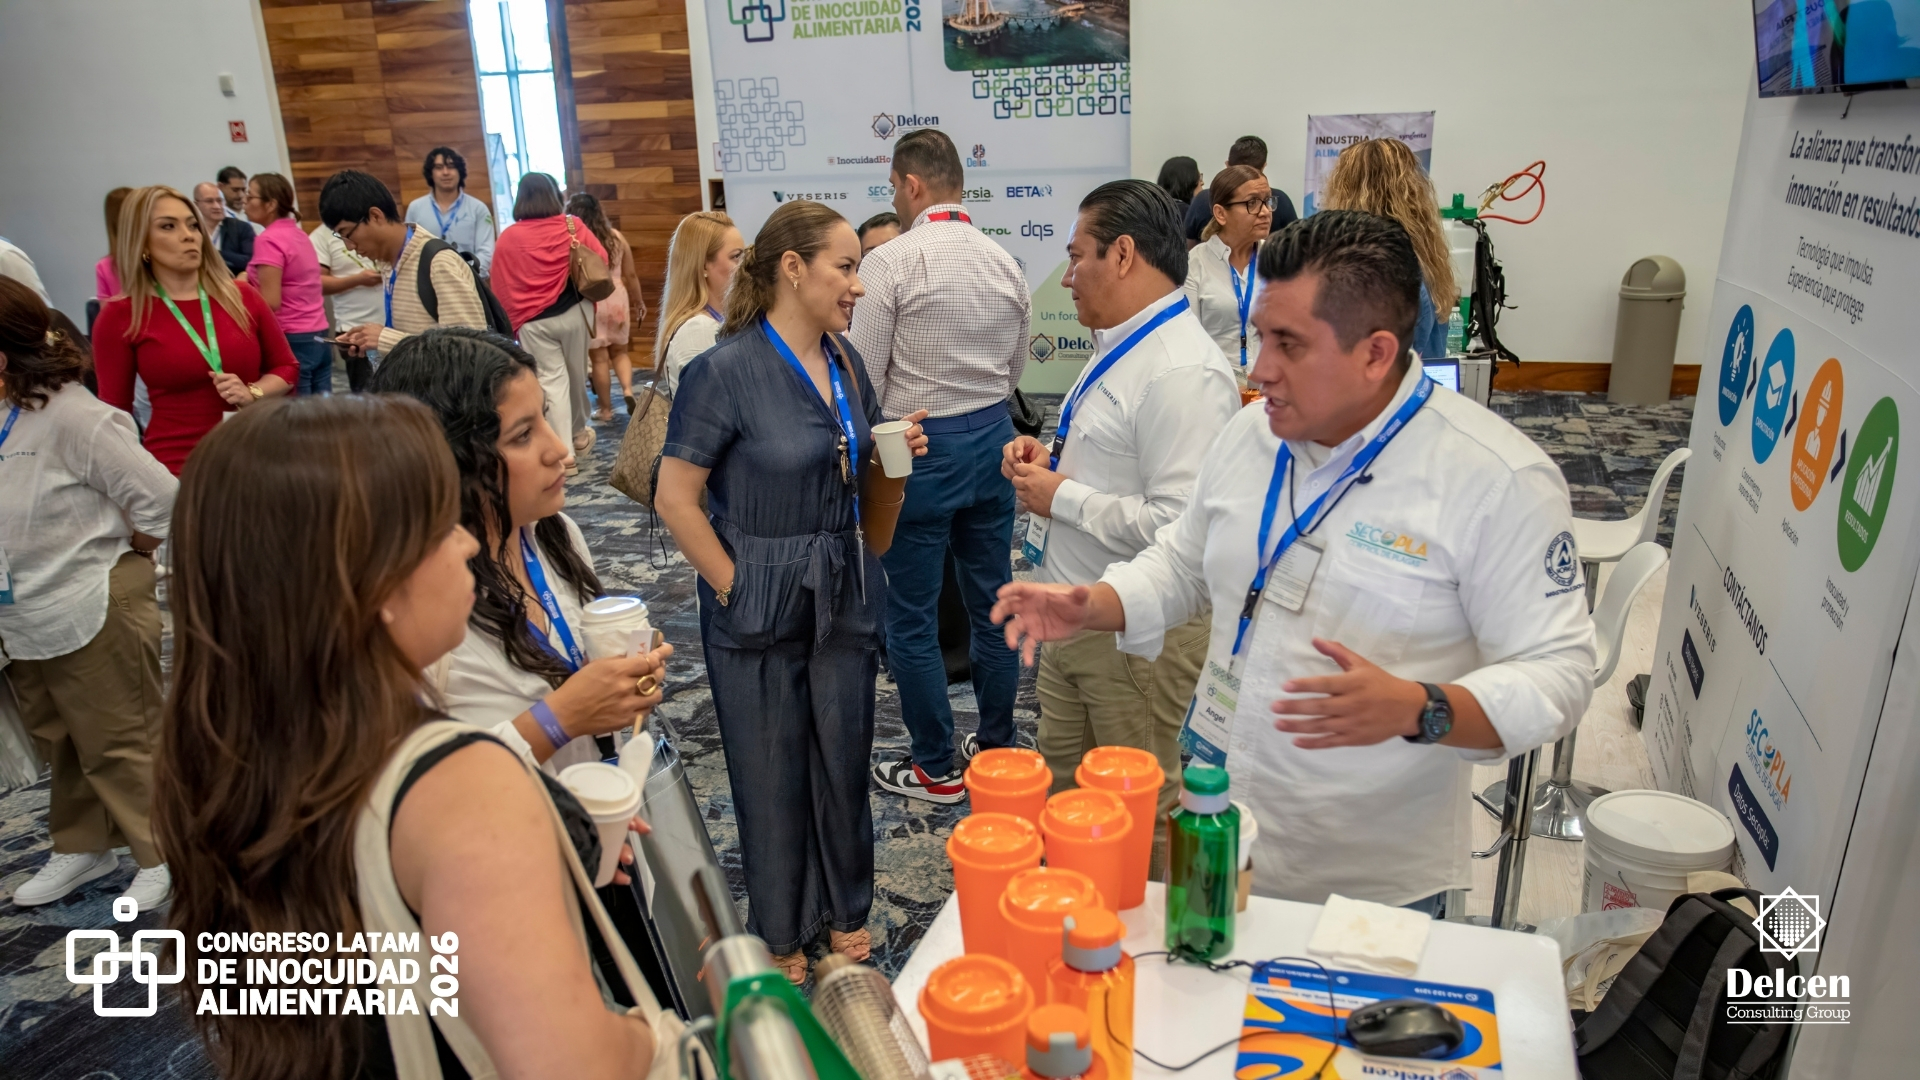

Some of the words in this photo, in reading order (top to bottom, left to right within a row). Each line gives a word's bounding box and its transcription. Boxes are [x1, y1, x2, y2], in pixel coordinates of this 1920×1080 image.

[791, 6, 811, 21] DE
[815, 1, 902, 20] INOCUIDAD
[793, 16, 903, 39] ALIMENTARIA
[897, 114, 939, 127] Delcen
[1790, 130, 1804, 159] La
[1803, 130, 1842, 164] alianza
[1841, 138, 1865, 174] que
[787, 192, 847, 201] VESERIS
[1006, 186, 1040, 198] BETA
[1785, 175, 1842, 215] innovación
[1841, 192, 1859, 219] en
[1020, 219, 1054, 241] dqs
[1796, 236, 1830, 271] Tecnología
[1829, 252, 1845, 275] que
[1844, 252, 1874, 287] impulsa.
[1787, 265, 1823, 298] Experiencia
[1822, 283, 1836, 308] que
[1835, 291, 1865, 325] protege.
[1040, 312, 1056, 321] Un
[1843, 508, 1870, 545] RESULTADOS
[1723, 565, 1769, 656] CONTÁCTANOS
[1694, 598, 1717, 654] VESERIS
[1205, 706, 1227, 725] Angel
[1733, 782, 1748, 815] Datos
